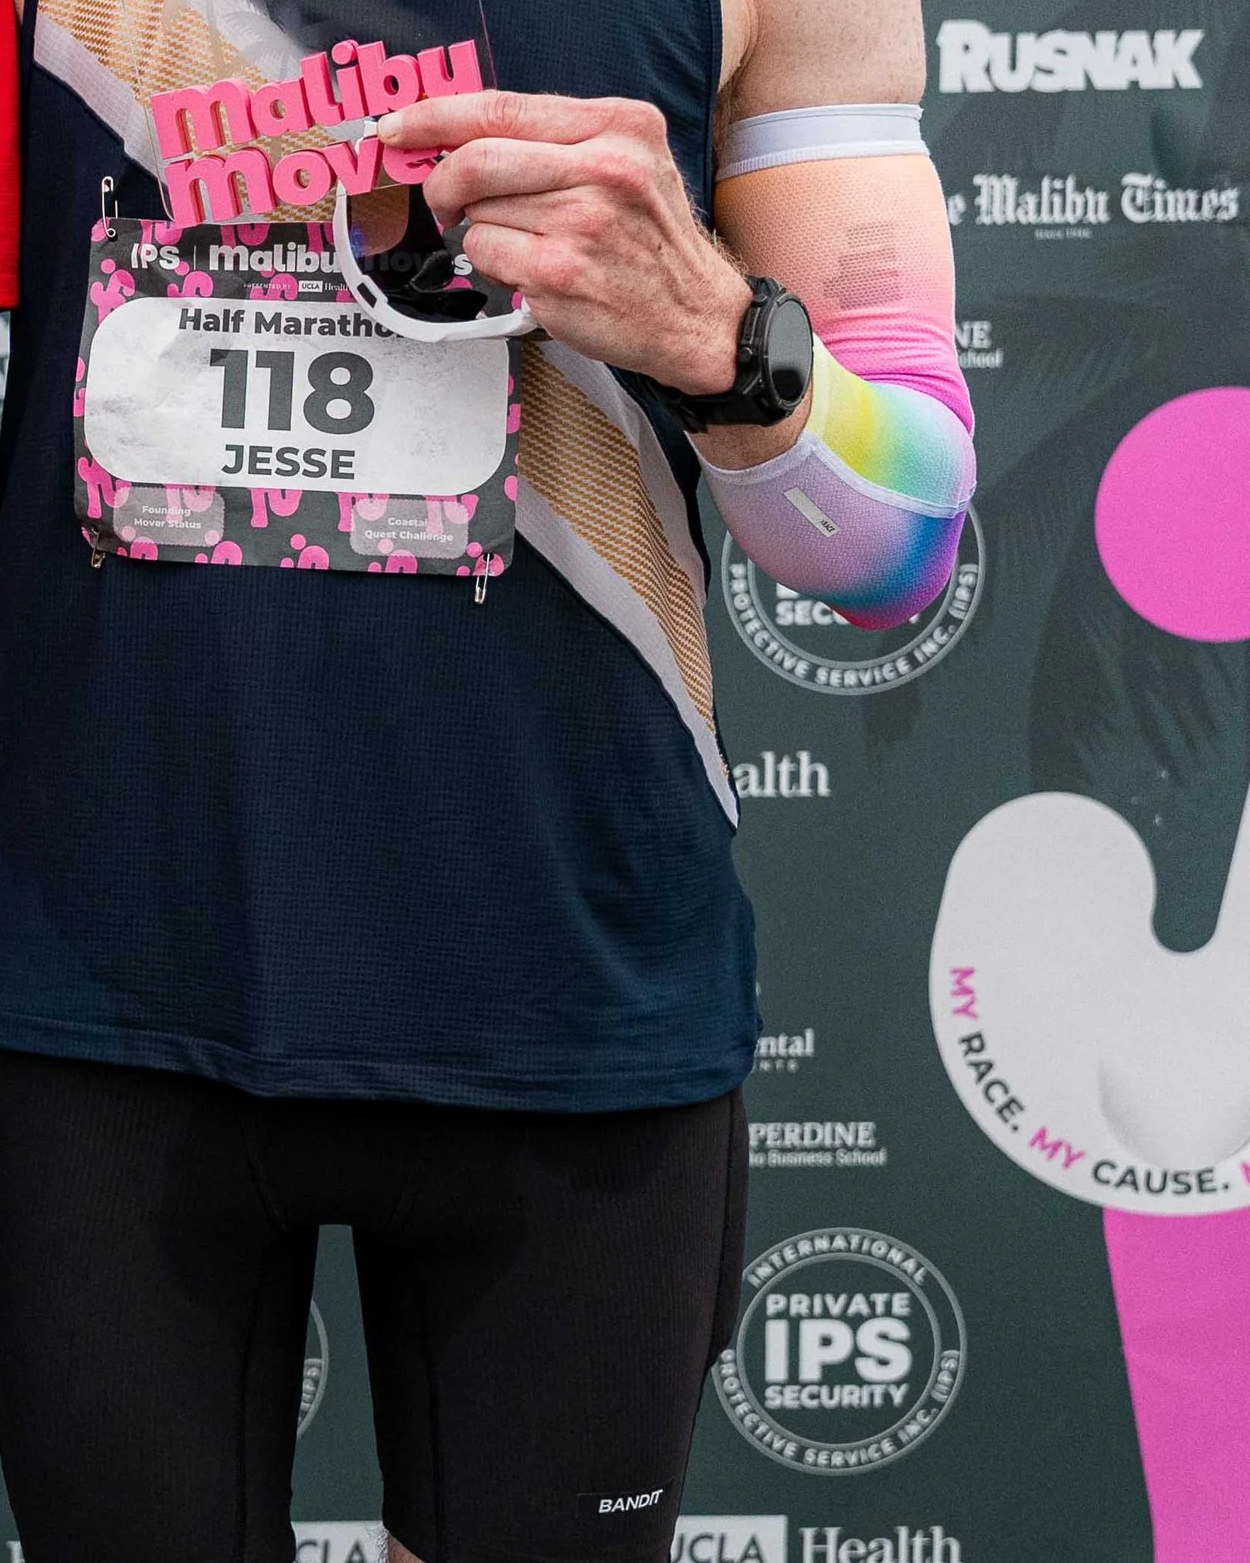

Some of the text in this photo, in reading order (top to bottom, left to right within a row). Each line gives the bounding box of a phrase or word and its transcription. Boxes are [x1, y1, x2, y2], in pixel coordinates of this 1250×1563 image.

[936, 18, 1205, 94] RUSNAK
[150, 39, 484, 161] malibu
[973, 173, 1111, 226] Malibu
[1121, 172, 1240, 224] Times
[130, 243, 180, 272] IPS
[209, 242, 338, 274] malibu
[301, 282, 321, 291] UCLA
[179, 308, 394, 338] Half Maratho
[209, 348, 376, 436] 118
[222, 443, 356, 480] JESSE
[134, 517, 202, 530] Mover Status
[141, 505, 192, 517] Founding
[388, 517, 429, 528] Coastal
[365, 528, 454, 543] Quest Challenge
[729, 564, 811, 679] PROTECTIVE
[815, 656, 912, 688] SERVICE
[734, 751, 831, 799] alth
[950, 967, 979, 1021] MY
[757, 1028, 814, 1058] ntal
[958, 1030, 1026, 1133] RACE.
[749, 1122, 877, 1149] PERDINE
[1028, 1126, 1086, 1172] MY
[1092, 1158, 1230, 1195] CAUSE.
[747, 1234, 928, 1287] INTERNATIONAL
[765, 1292, 911, 1318] PRIVATE
[765, 1317, 912, 1384] IPS
[720, 1349, 797, 1460] PROTECTIVE
[803, 1437, 898, 1468] SERVICE
[764, 1384, 909, 1409] SECURITY
[598, 1489, 663, 1514] BANDIT
[799, 1525, 962, 1563] Health
